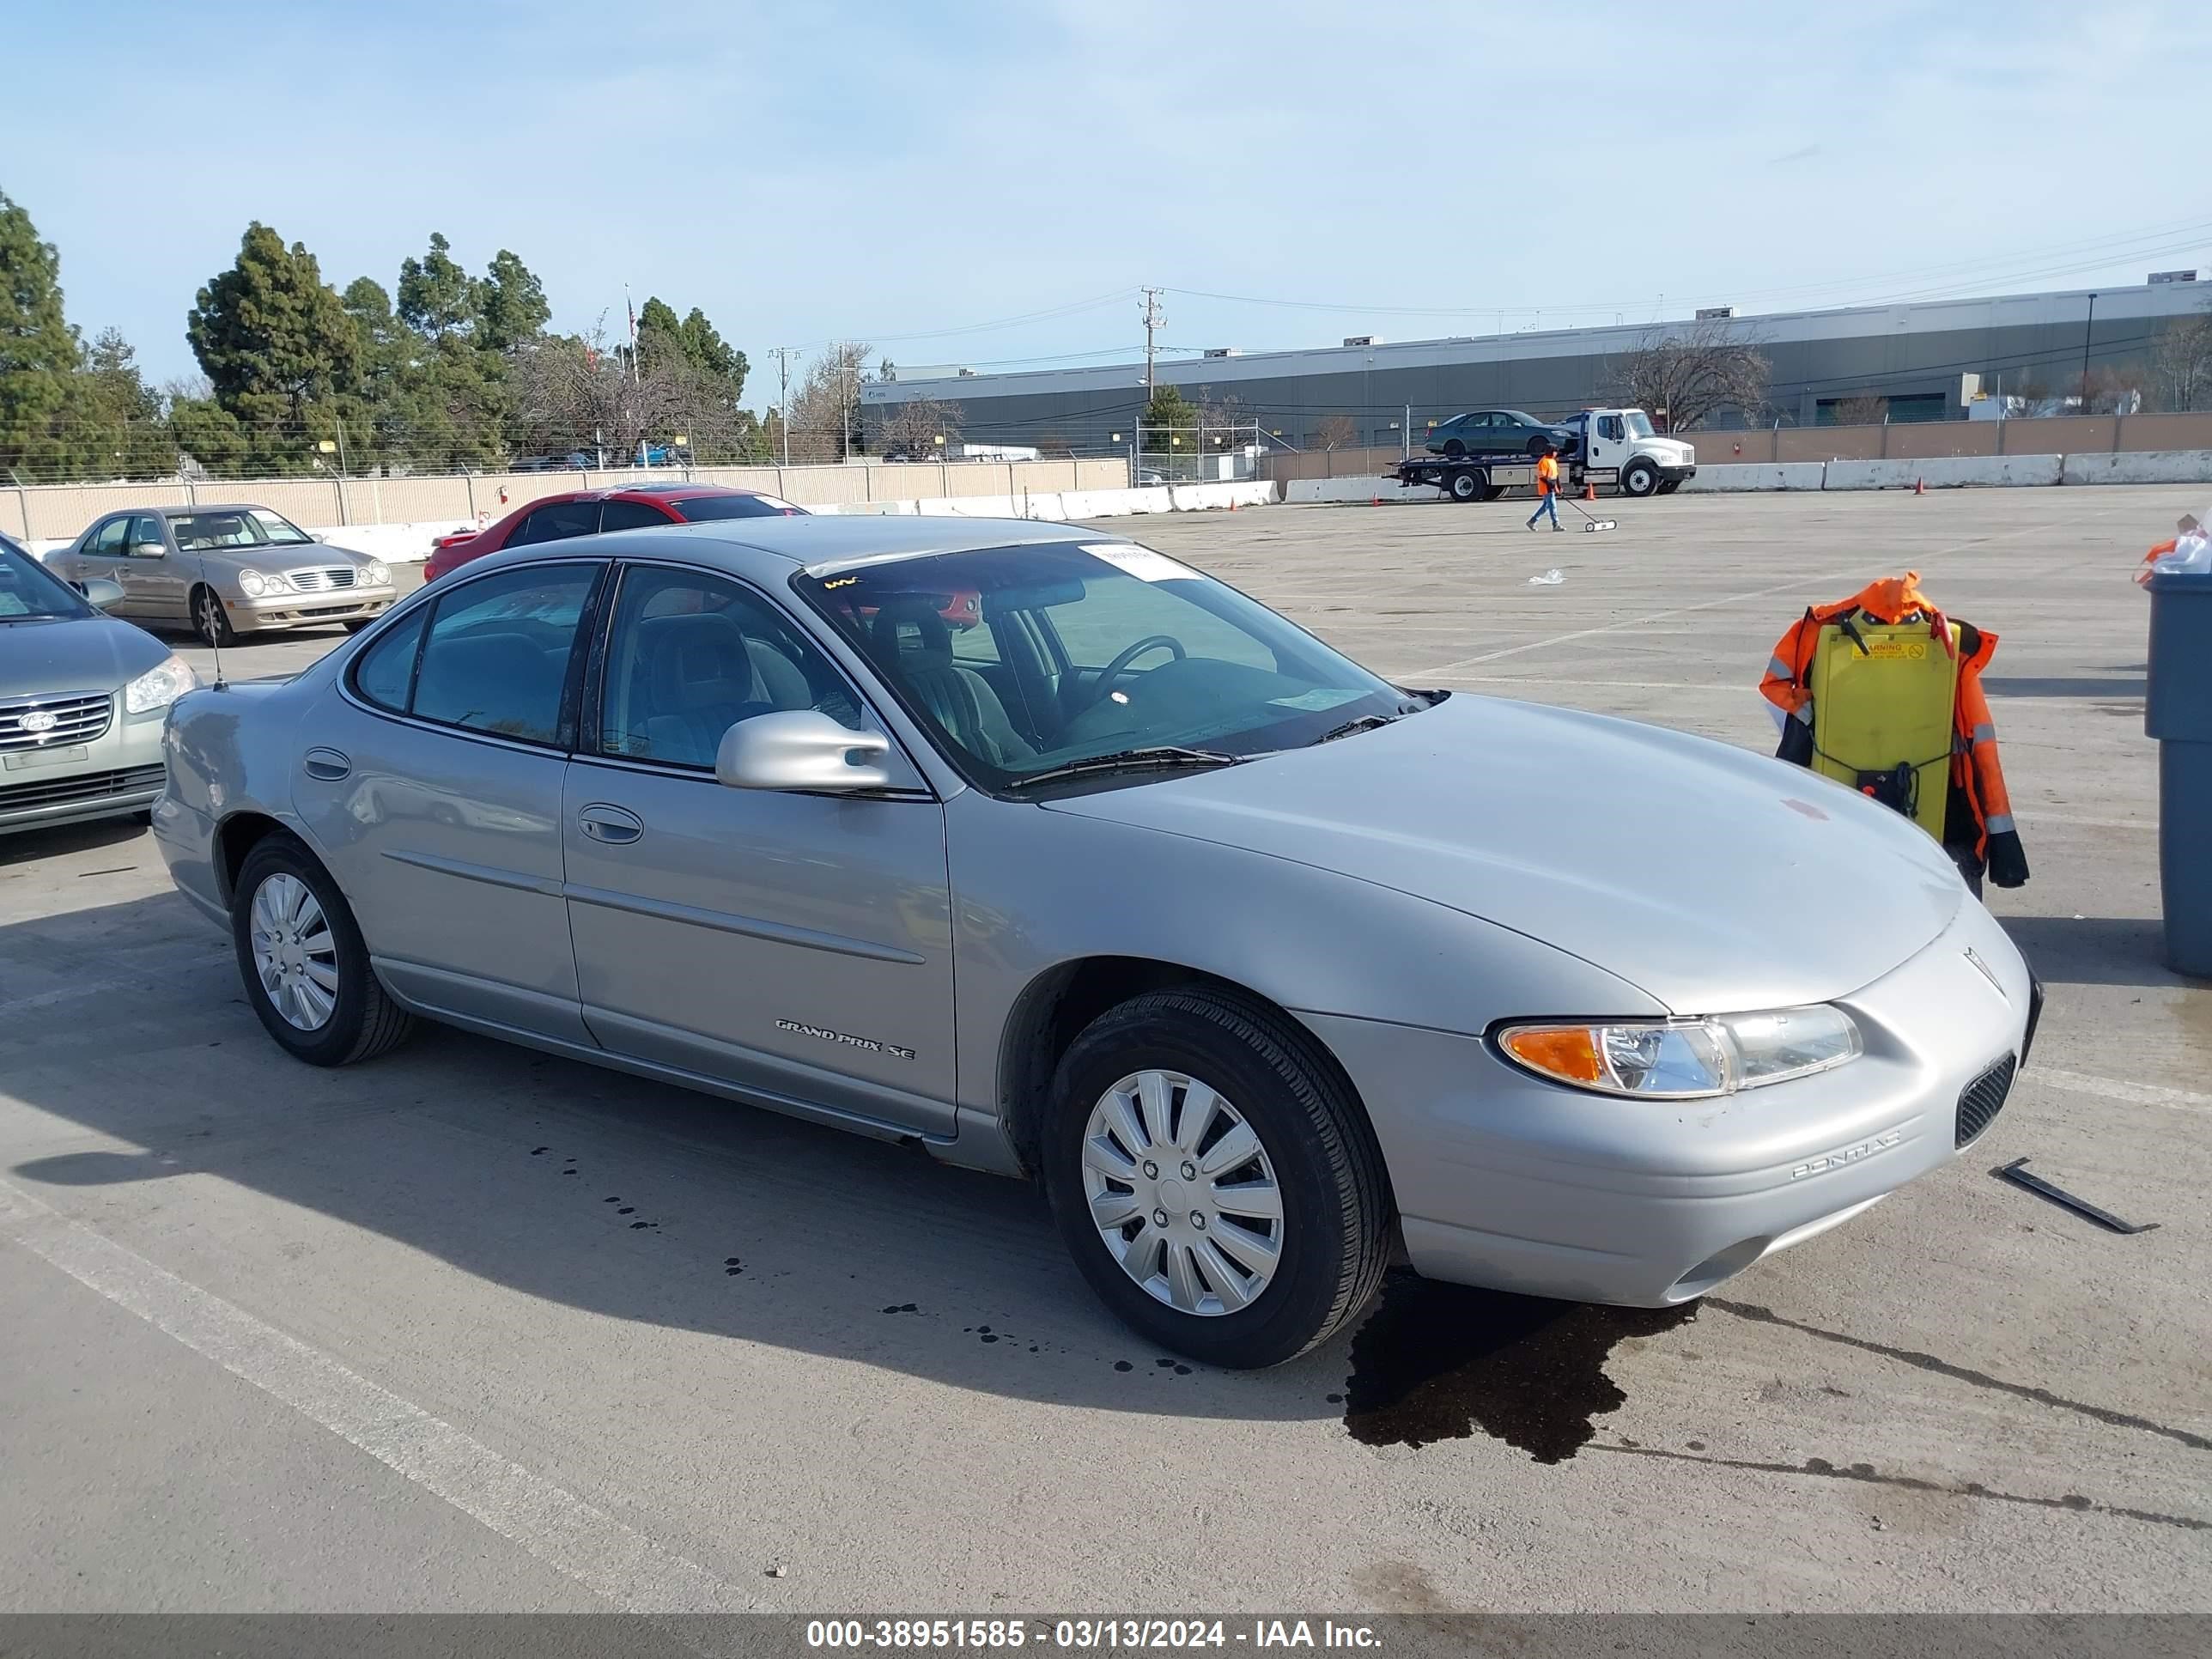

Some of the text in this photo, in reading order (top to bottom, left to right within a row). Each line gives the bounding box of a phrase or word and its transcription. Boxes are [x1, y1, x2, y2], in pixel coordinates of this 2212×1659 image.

[775, 1018, 915, 1060] GRAND PRIX SE
[1791, 1130, 1900, 1180] PONTIAC
